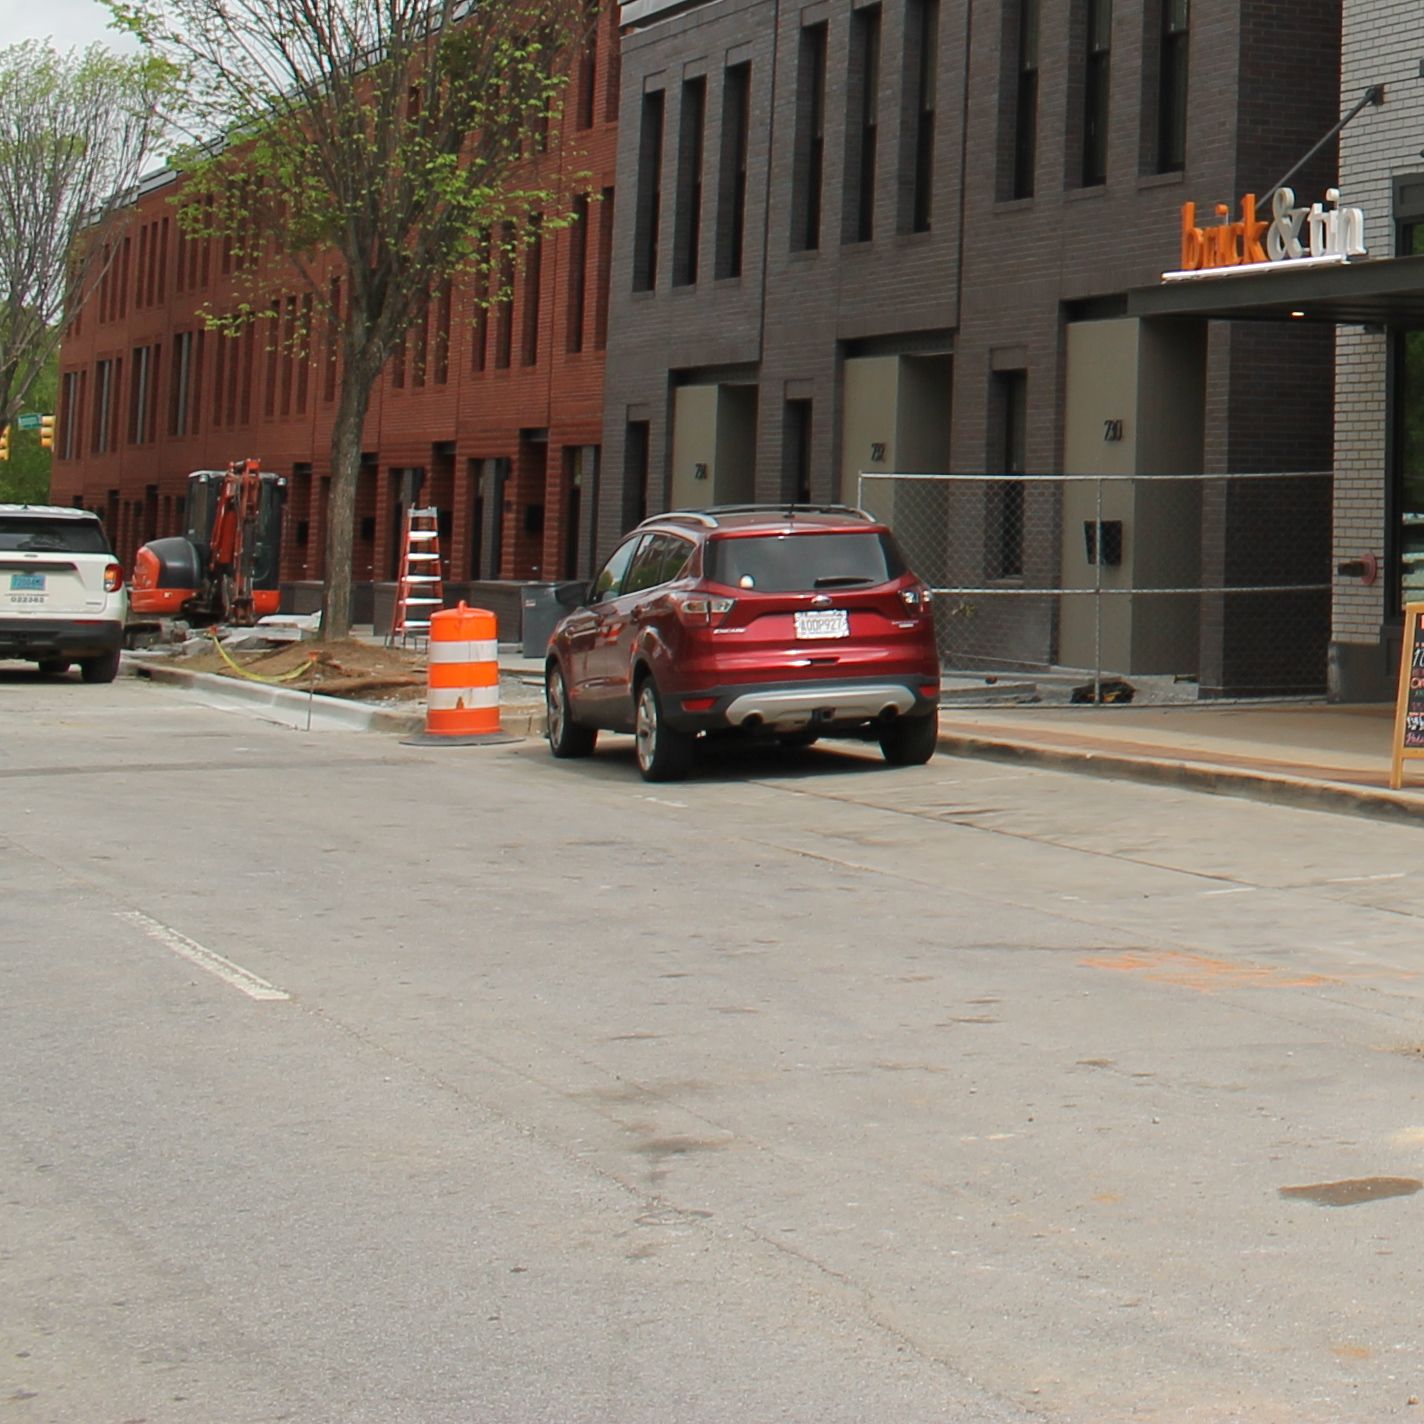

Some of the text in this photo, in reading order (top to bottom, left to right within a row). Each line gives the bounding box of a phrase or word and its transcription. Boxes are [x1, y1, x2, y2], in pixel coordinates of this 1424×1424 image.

[1180, 187, 1368, 271] brick & tin
